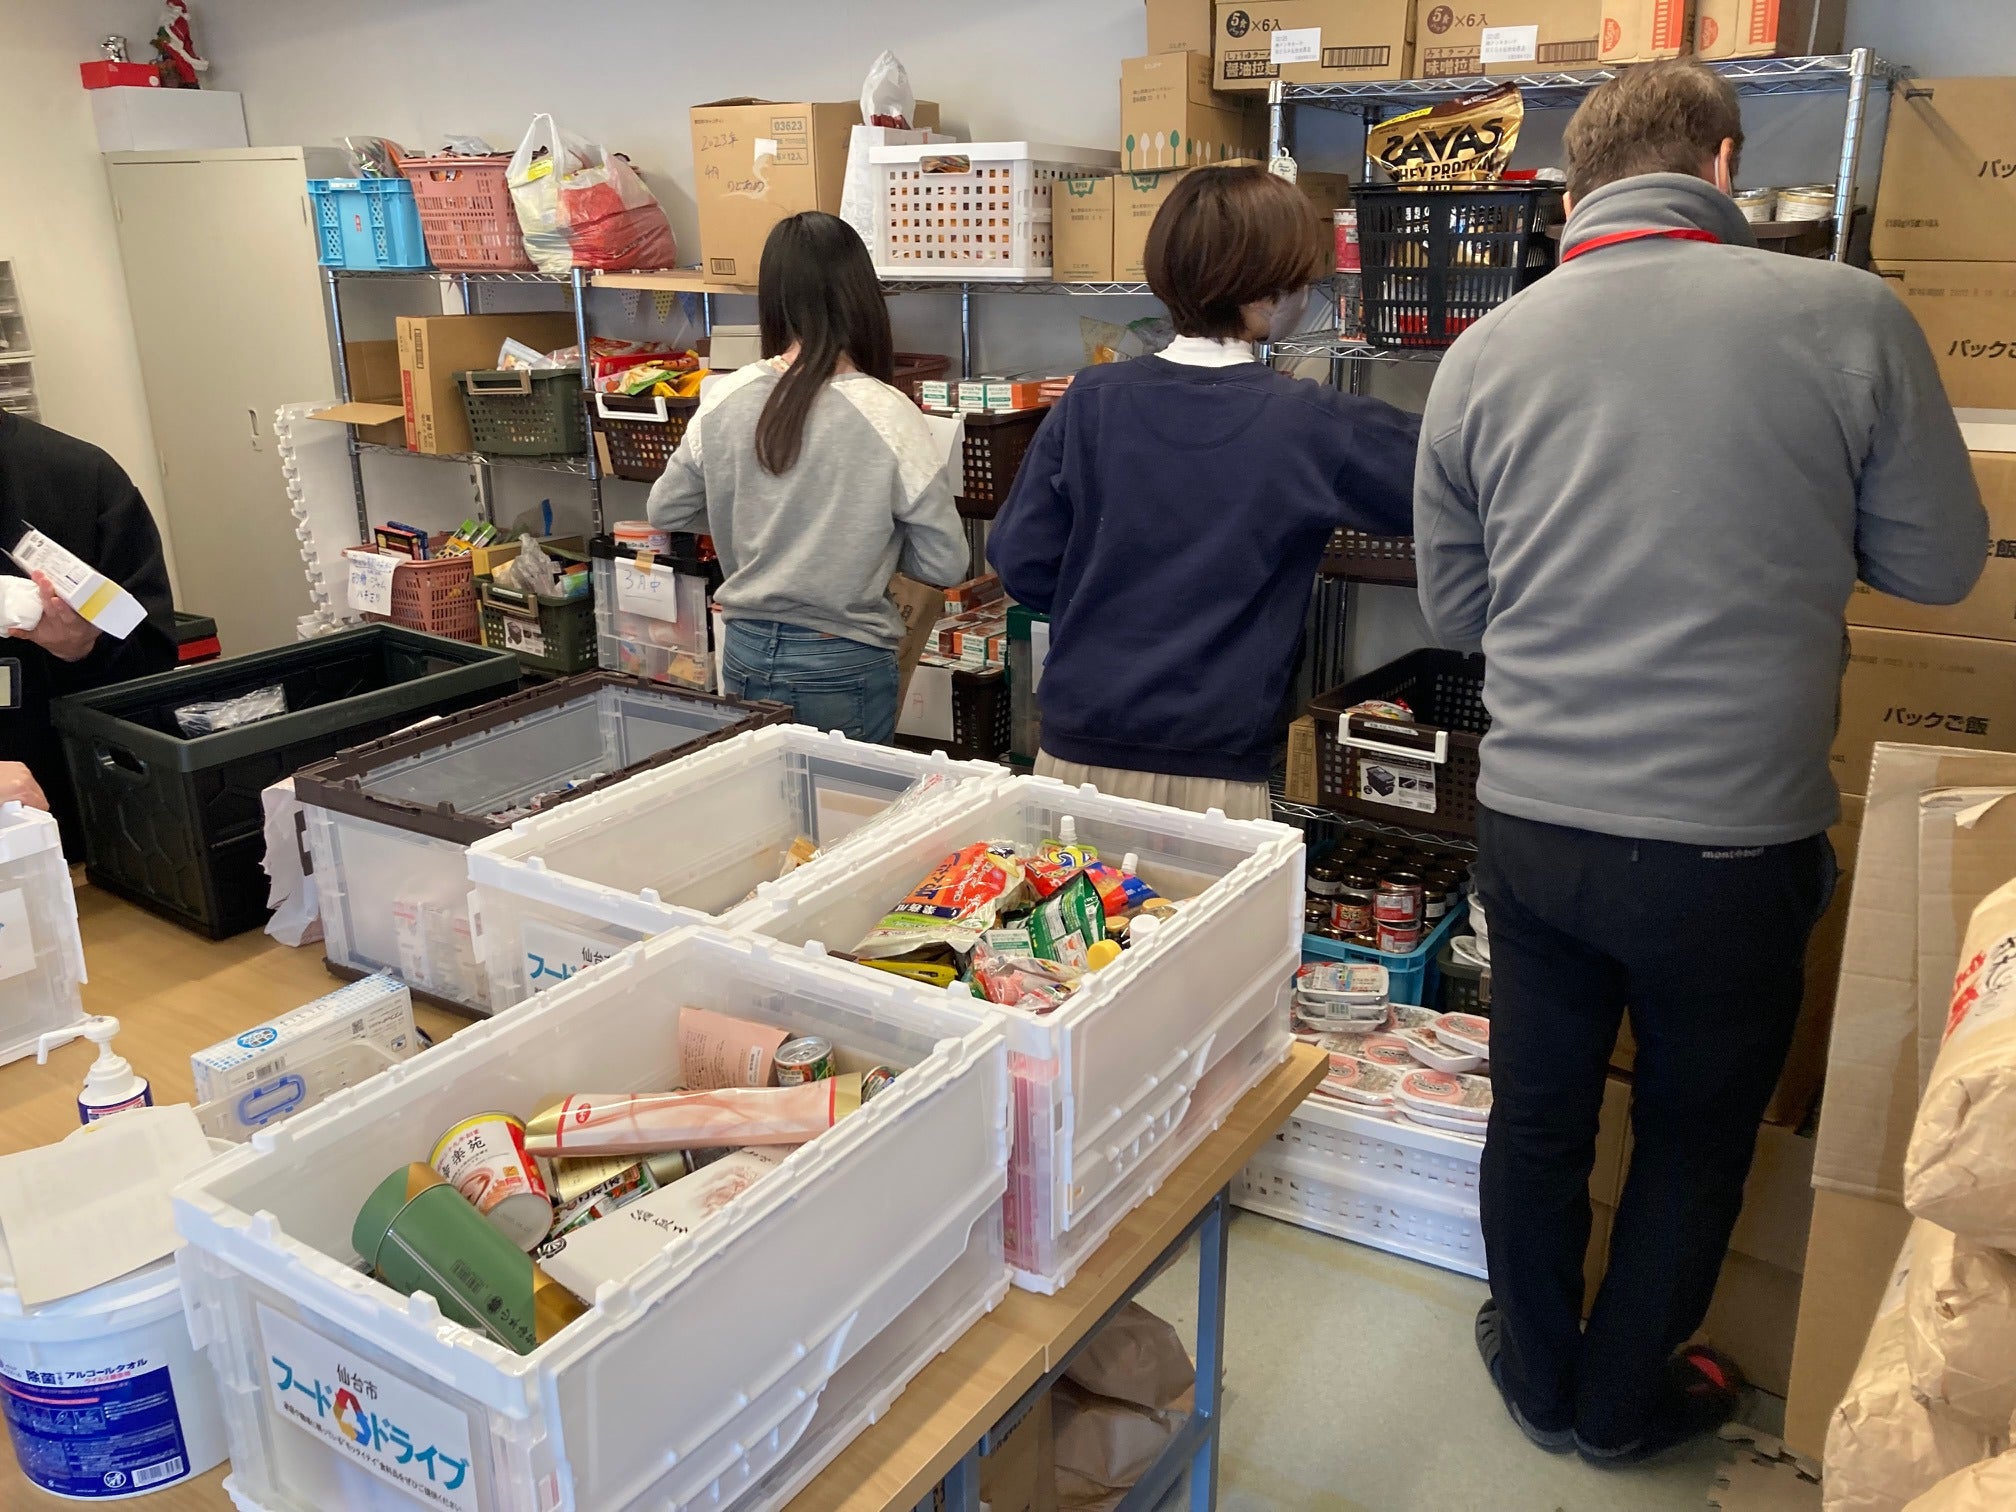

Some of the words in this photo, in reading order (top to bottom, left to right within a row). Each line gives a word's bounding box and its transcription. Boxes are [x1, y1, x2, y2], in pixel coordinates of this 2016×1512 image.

[774, 121, 803, 131] 03623
[1381, 117, 1504, 165] SAVAS
[1884, 707, 1990, 736] パックご飯
[65, 1358, 149, 1380] アルコールタオル
[336, 1364, 379, 1400] 仙台市
[271, 1355, 334, 1417] フード
[370, 1412, 470, 1490] ドライブ
